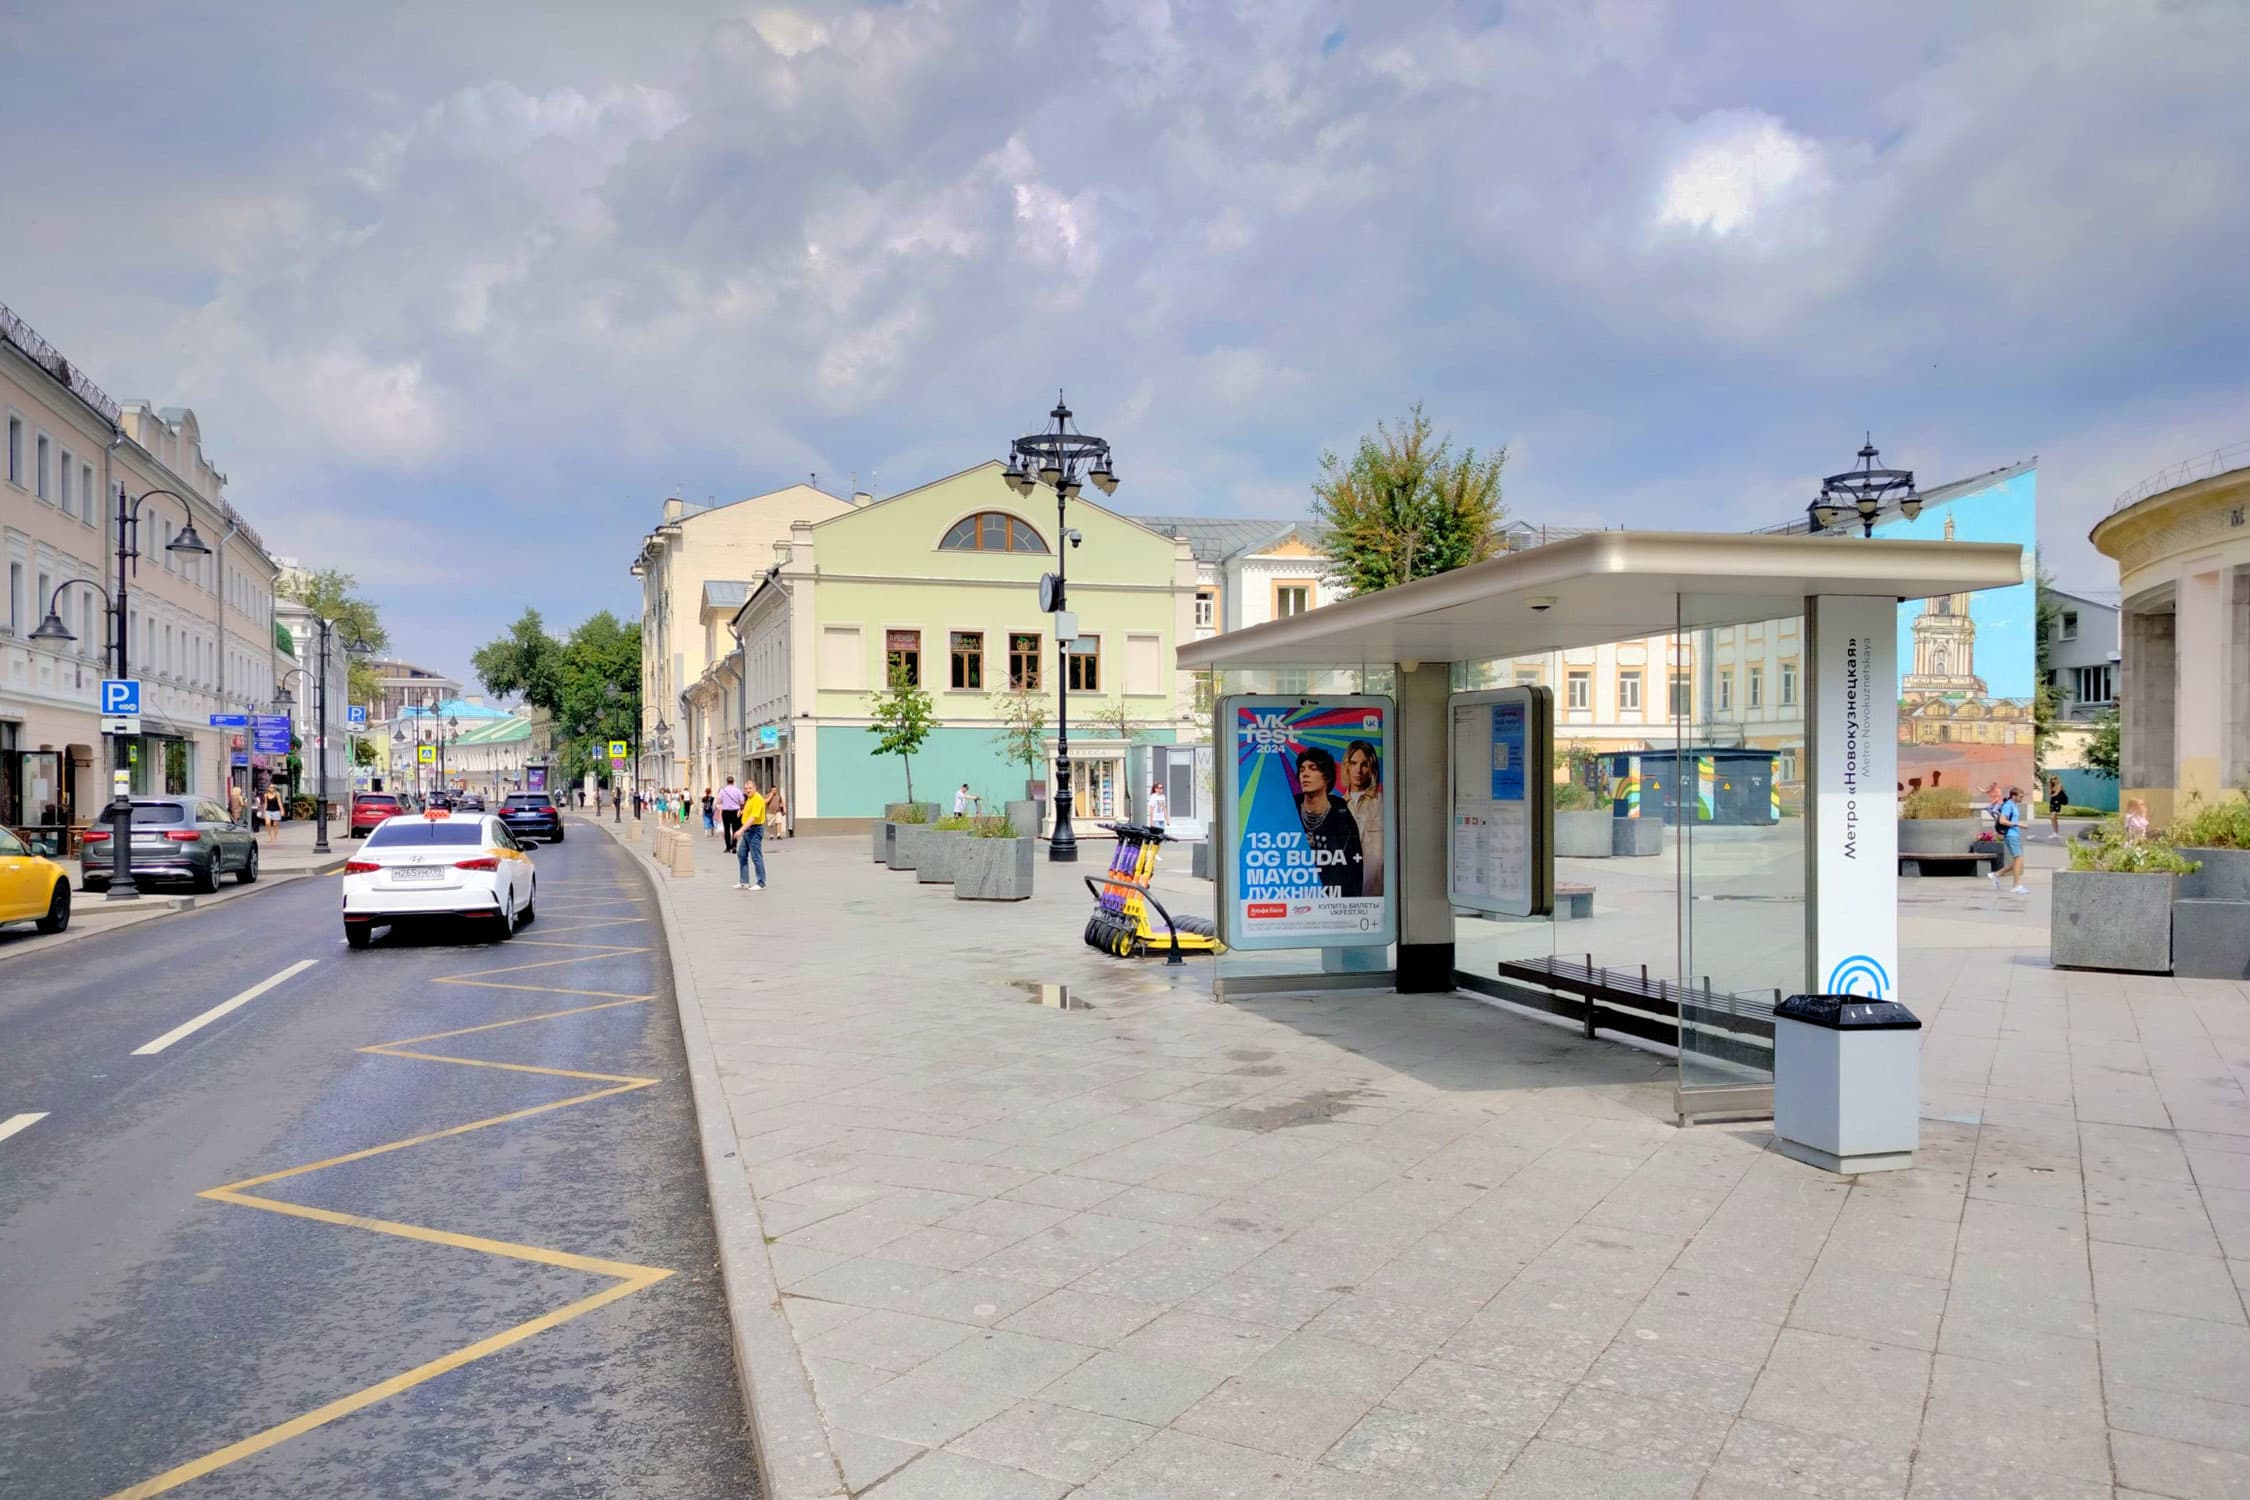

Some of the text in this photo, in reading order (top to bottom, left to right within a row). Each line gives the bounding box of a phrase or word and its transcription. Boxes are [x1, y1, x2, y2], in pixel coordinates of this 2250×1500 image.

[108, 684, 130, 711] P
[1862, 637, 1873, 778] Metro Novokuznetskaya
[1255, 714, 1288, 729] VK
[1245, 723, 1302, 744] fest
[1256, 744, 1286, 753] 2024
[1844, 638, 1859, 860] Метро «Новокузнецкая»
[1246, 832, 1302, 849] 13.07
[1246, 850, 1281, 867] OG
[1286, 849, 1348, 866] BUDA
[1246, 867, 1322, 885] MAYOT
[1247, 885, 1343, 900] ЛУЖНИКИ
